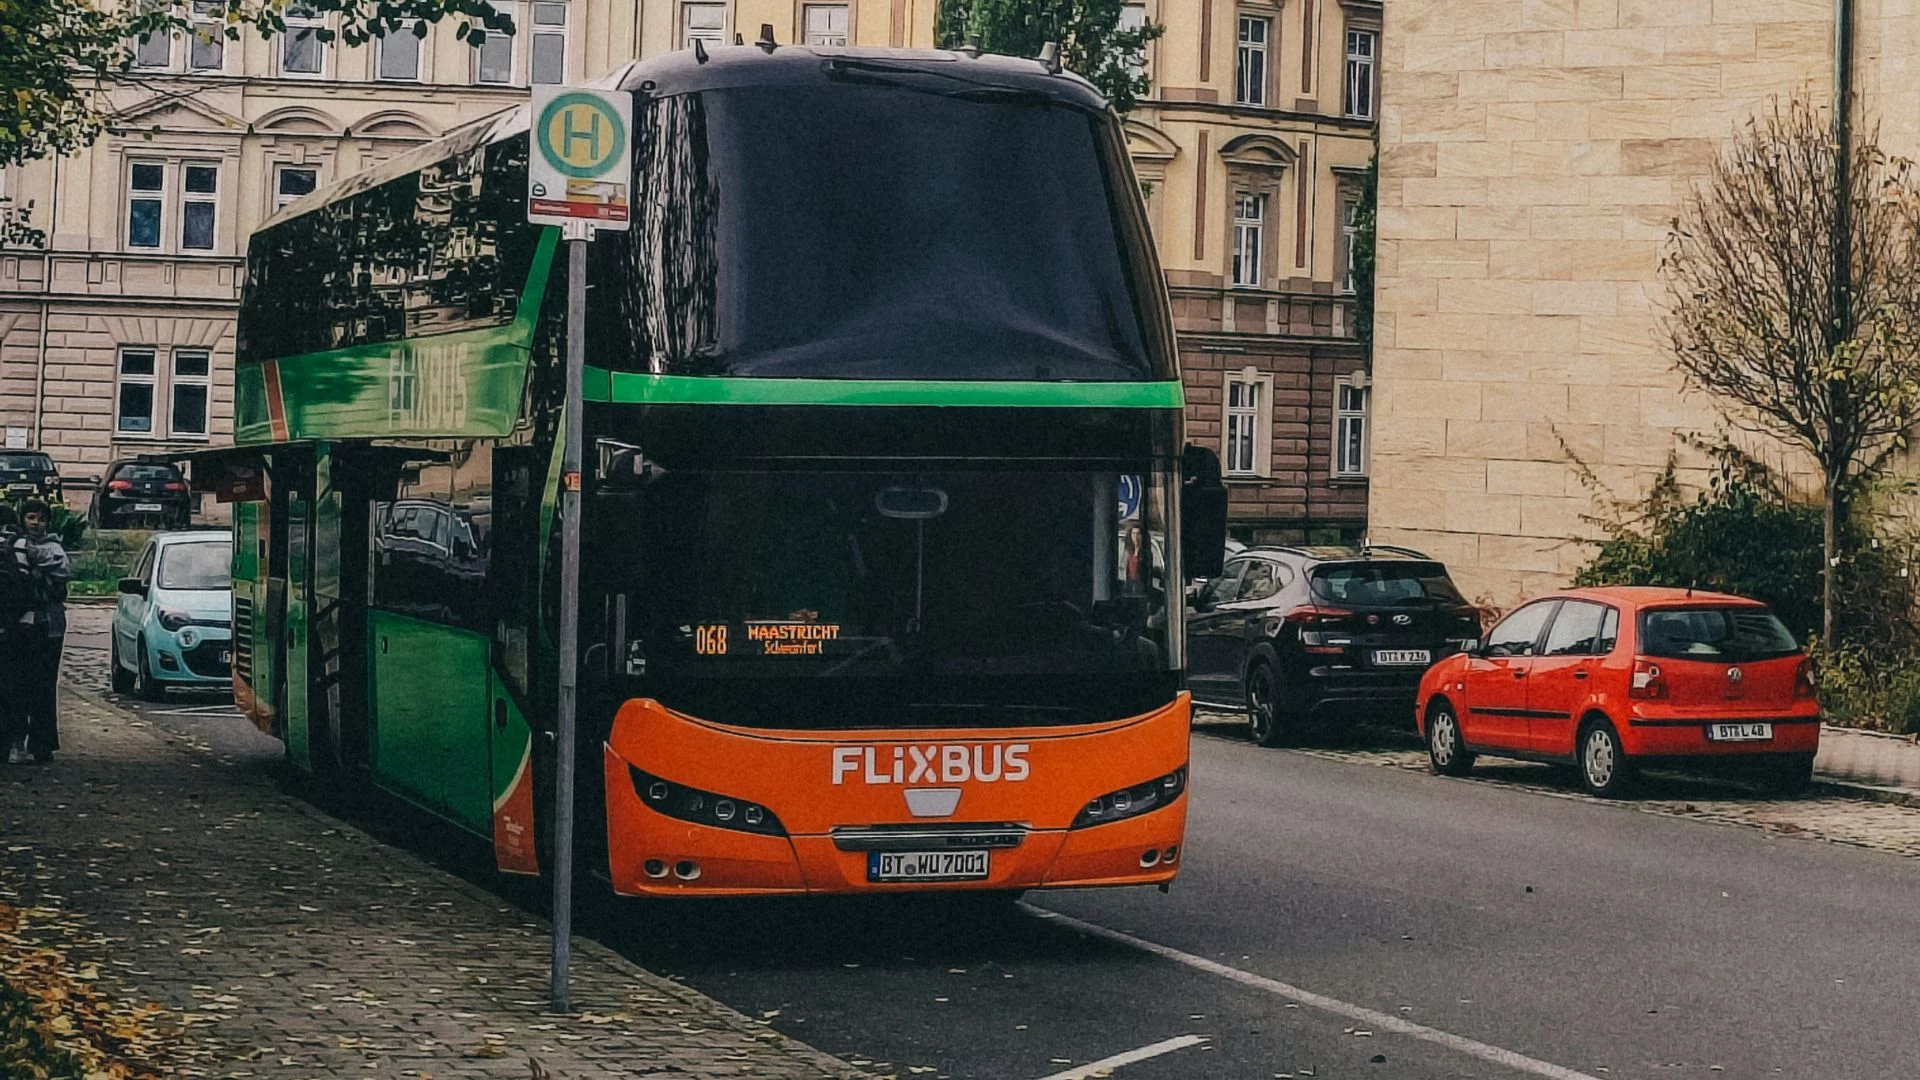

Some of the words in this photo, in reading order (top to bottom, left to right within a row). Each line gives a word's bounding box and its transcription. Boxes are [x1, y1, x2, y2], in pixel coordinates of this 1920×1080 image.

[563, 110, 600, 160] H
[696, 625, 727, 654] 068
[748, 625, 840, 640] MAASTRICHT
[1720, 725, 1734, 737] BT
[881, 855, 904, 875] BT
[918, 855, 940, 874] WU
[943, 854, 986, 874] 7001
